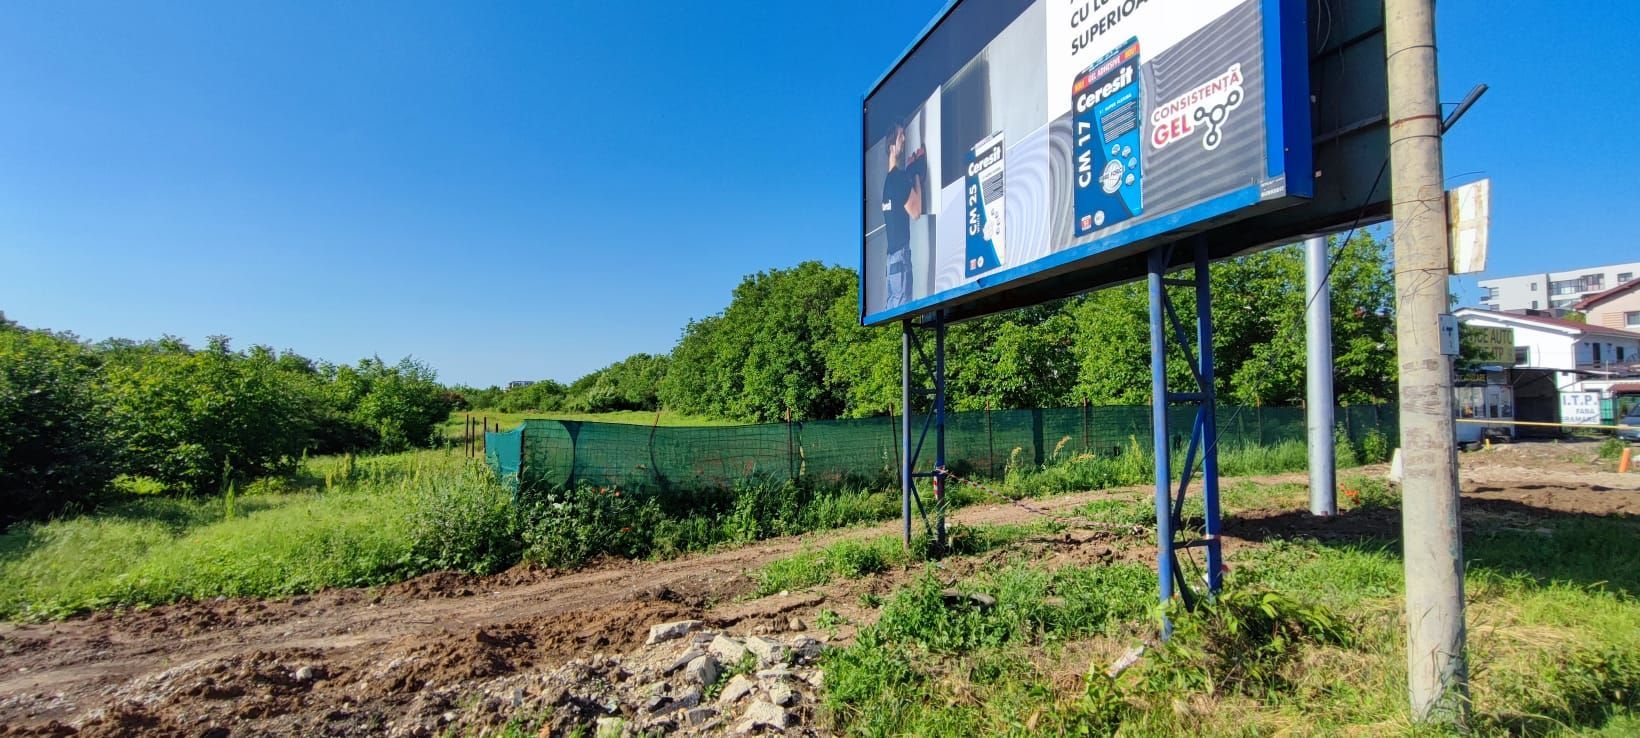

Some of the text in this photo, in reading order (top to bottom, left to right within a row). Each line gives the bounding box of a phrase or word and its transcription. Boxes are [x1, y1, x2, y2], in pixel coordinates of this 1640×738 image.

[1071, 3, 1089, 28] CU
[1077, 65, 1133, 113] Ceresit
[1154, 114, 1191, 145] GEL
[968, 146, 1002, 176] Ceresit
[1078, 122, 1091, 188] CM 17
[969, 184, 977, 236] CM 25
[1491, 327, 1513, 344] AUTO
[1562, 394, 1598, 406] I.T.P.
